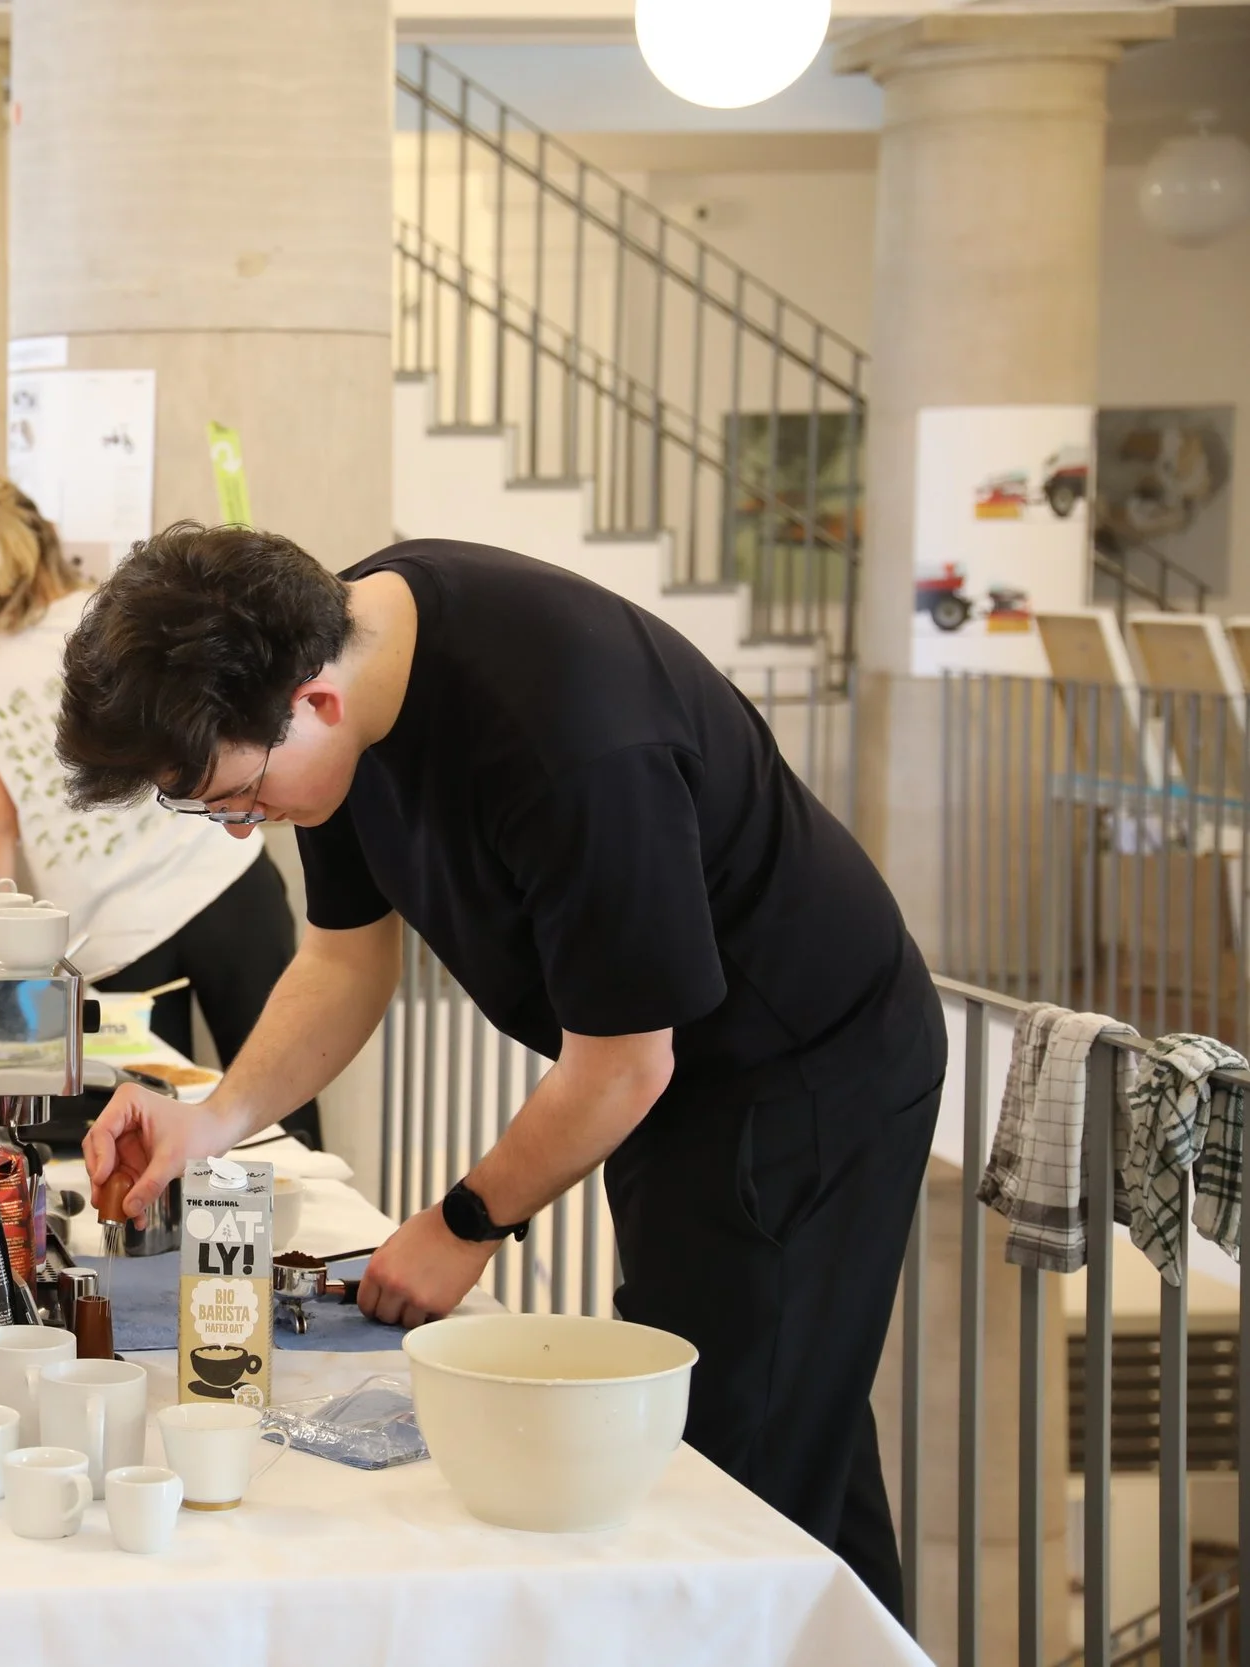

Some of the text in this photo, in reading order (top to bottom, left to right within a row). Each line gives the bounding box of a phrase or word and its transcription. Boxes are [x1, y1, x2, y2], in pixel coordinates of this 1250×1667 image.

[186, 1199, 240, 1208] THE ORIGINAL
[198, 1242, 255, 1276] LY!
[215, 1288, 235, 1305] BIO
[198, 1304, 251, 1322] BARISTA
[205, 1323, 244, 1334] HAFER OAT
